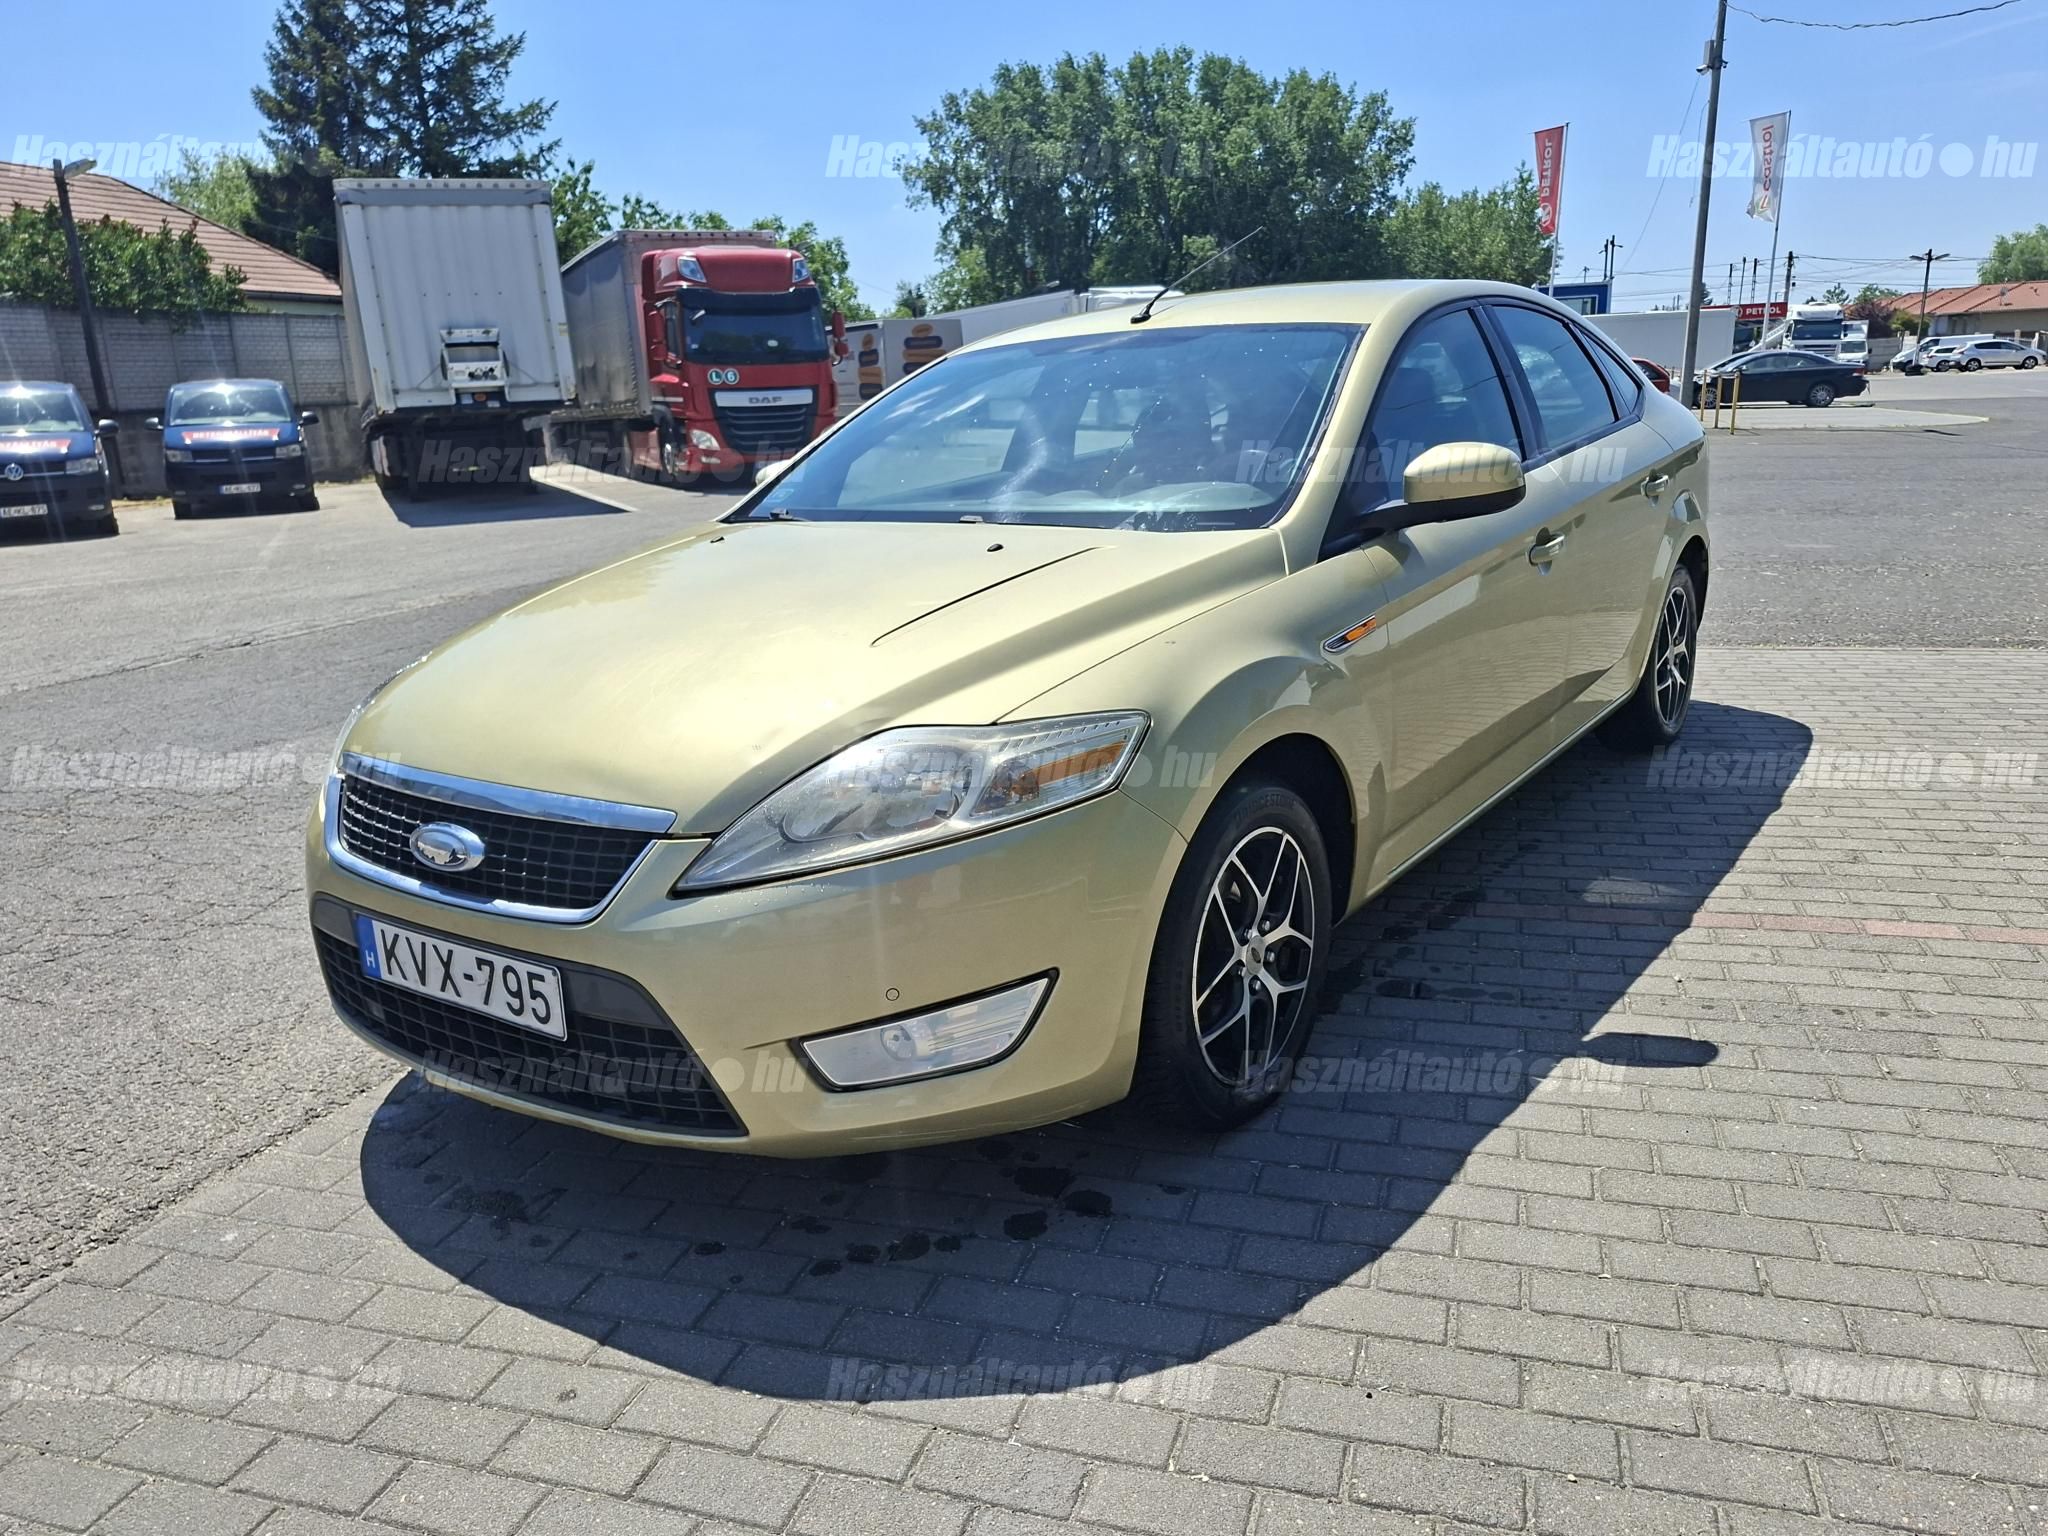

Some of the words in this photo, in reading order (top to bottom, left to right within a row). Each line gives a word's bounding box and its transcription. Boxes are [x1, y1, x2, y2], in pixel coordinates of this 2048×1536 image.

[1746, 306, 1782, 315] PETOL
[748, 396, 782, 404] DAF
[365, 951, 376, 968] H
[380, 929, 551, 1025] KVX-795
